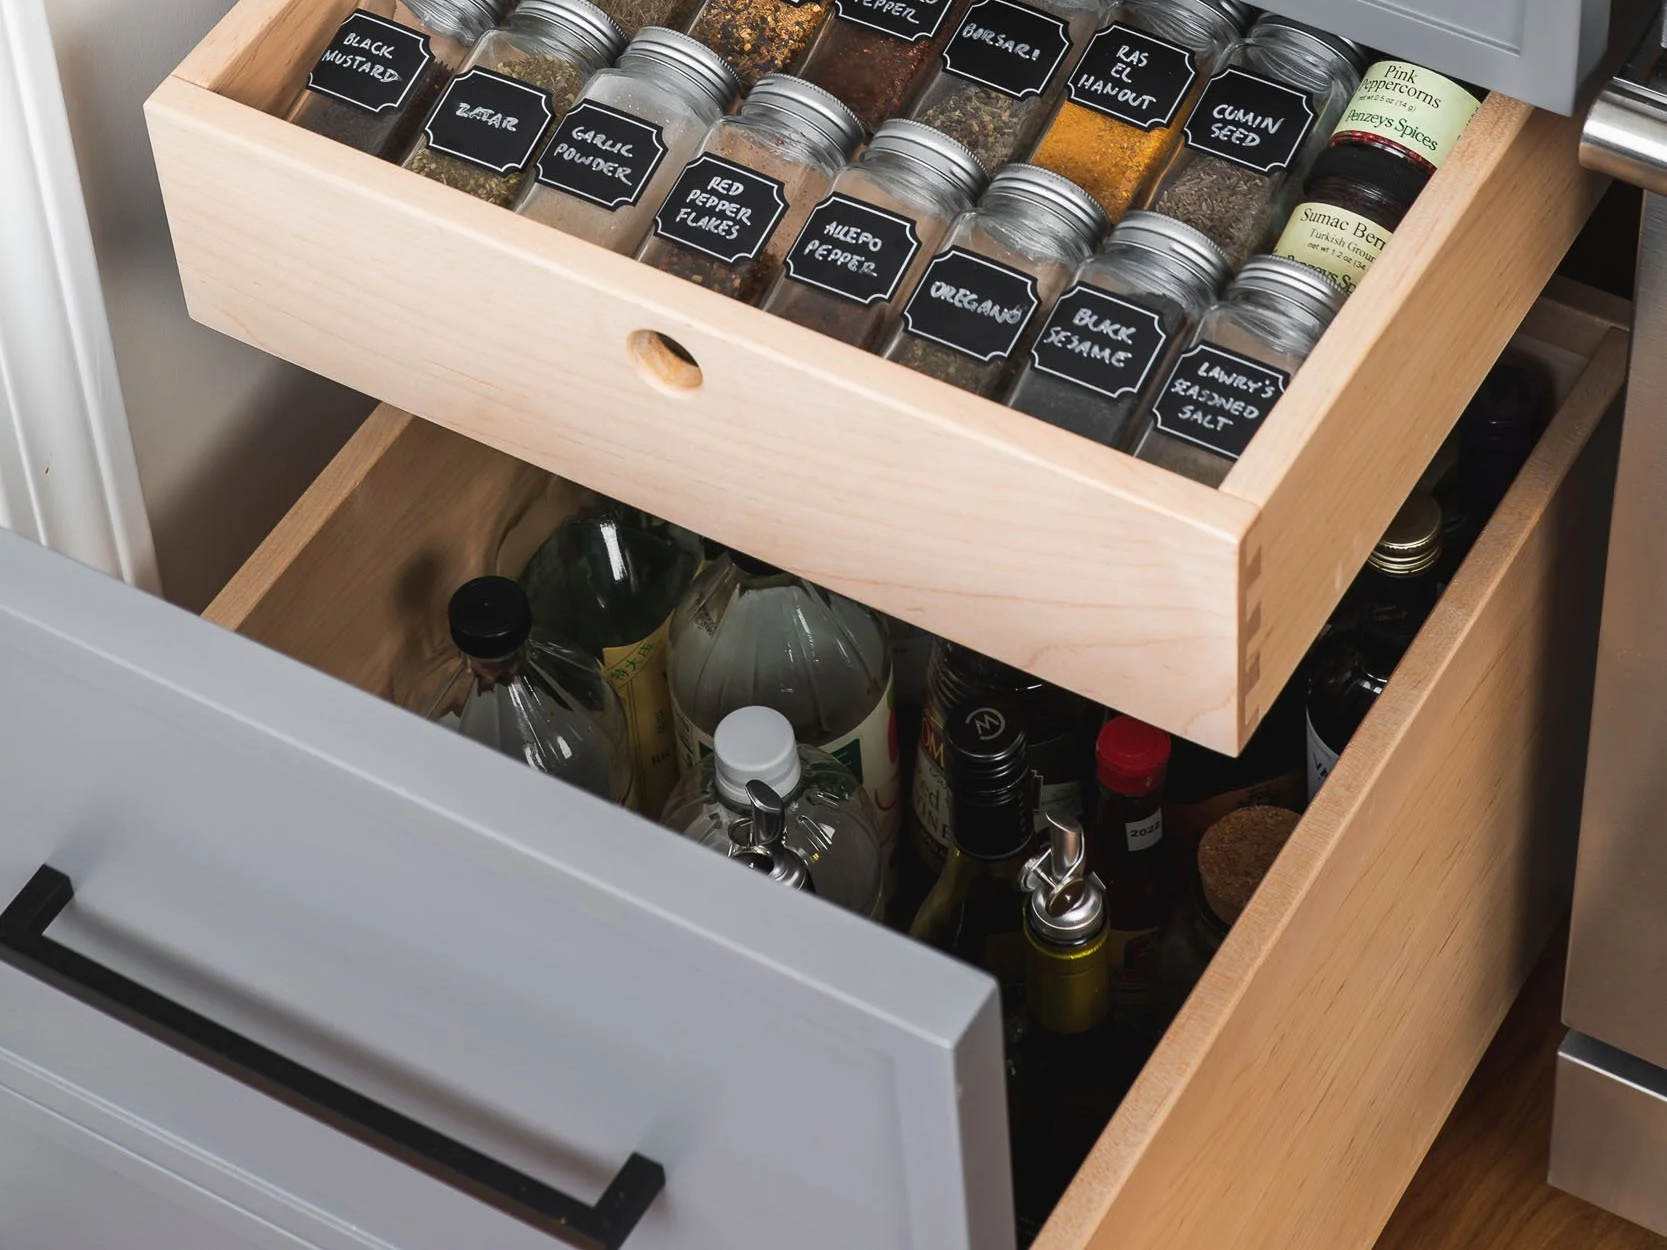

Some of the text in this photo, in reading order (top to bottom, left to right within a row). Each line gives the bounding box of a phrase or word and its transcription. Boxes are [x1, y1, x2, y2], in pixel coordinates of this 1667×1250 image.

[343, 32, 394, 60] BLACK
[962, 23, 1040, 61] BORSARI
[1116, 45, 1149, 68] RAS
[321, 49, 400, 84] MUSTARD
[1110, 62, 1132, 83] EL
[1384, 65, 1418, 84] Pink
[1077, 74, 1157, 110] HANOUT
[1359, 78, 1442, 109] Peppercorns
[1211, 123, 1260, 147] SEED
[1212, 104, 1285, 135] CUMIN
[1345, 109, 1394, 128] Penzeys
[1394, 117, 1438, 151] Spices
[571, 125, 633, 158] GARLIC
[553, 143, 633, 186] POWDER
[707, 176, 744, 196] RED
[675, 208, 739, 239] FLAKES
[686, 189, 752, 226] PEPPER
[1300, 208, 1349, 231] Sumac
[1310, 228, 1345, 247] Turkish
[803, 239, 878, 277] PEPPER
[929, 280, 1025, 325] OREGANO
[1072, 307, 1137, 345] BLACK
[1043, 326, 1132, 368] SESAME
[1198, 361, 1275, 398] LAWRY'S
[1170, 378, 1260, 419] SEASONED
[1178, 405, 1234, 431] SALT
